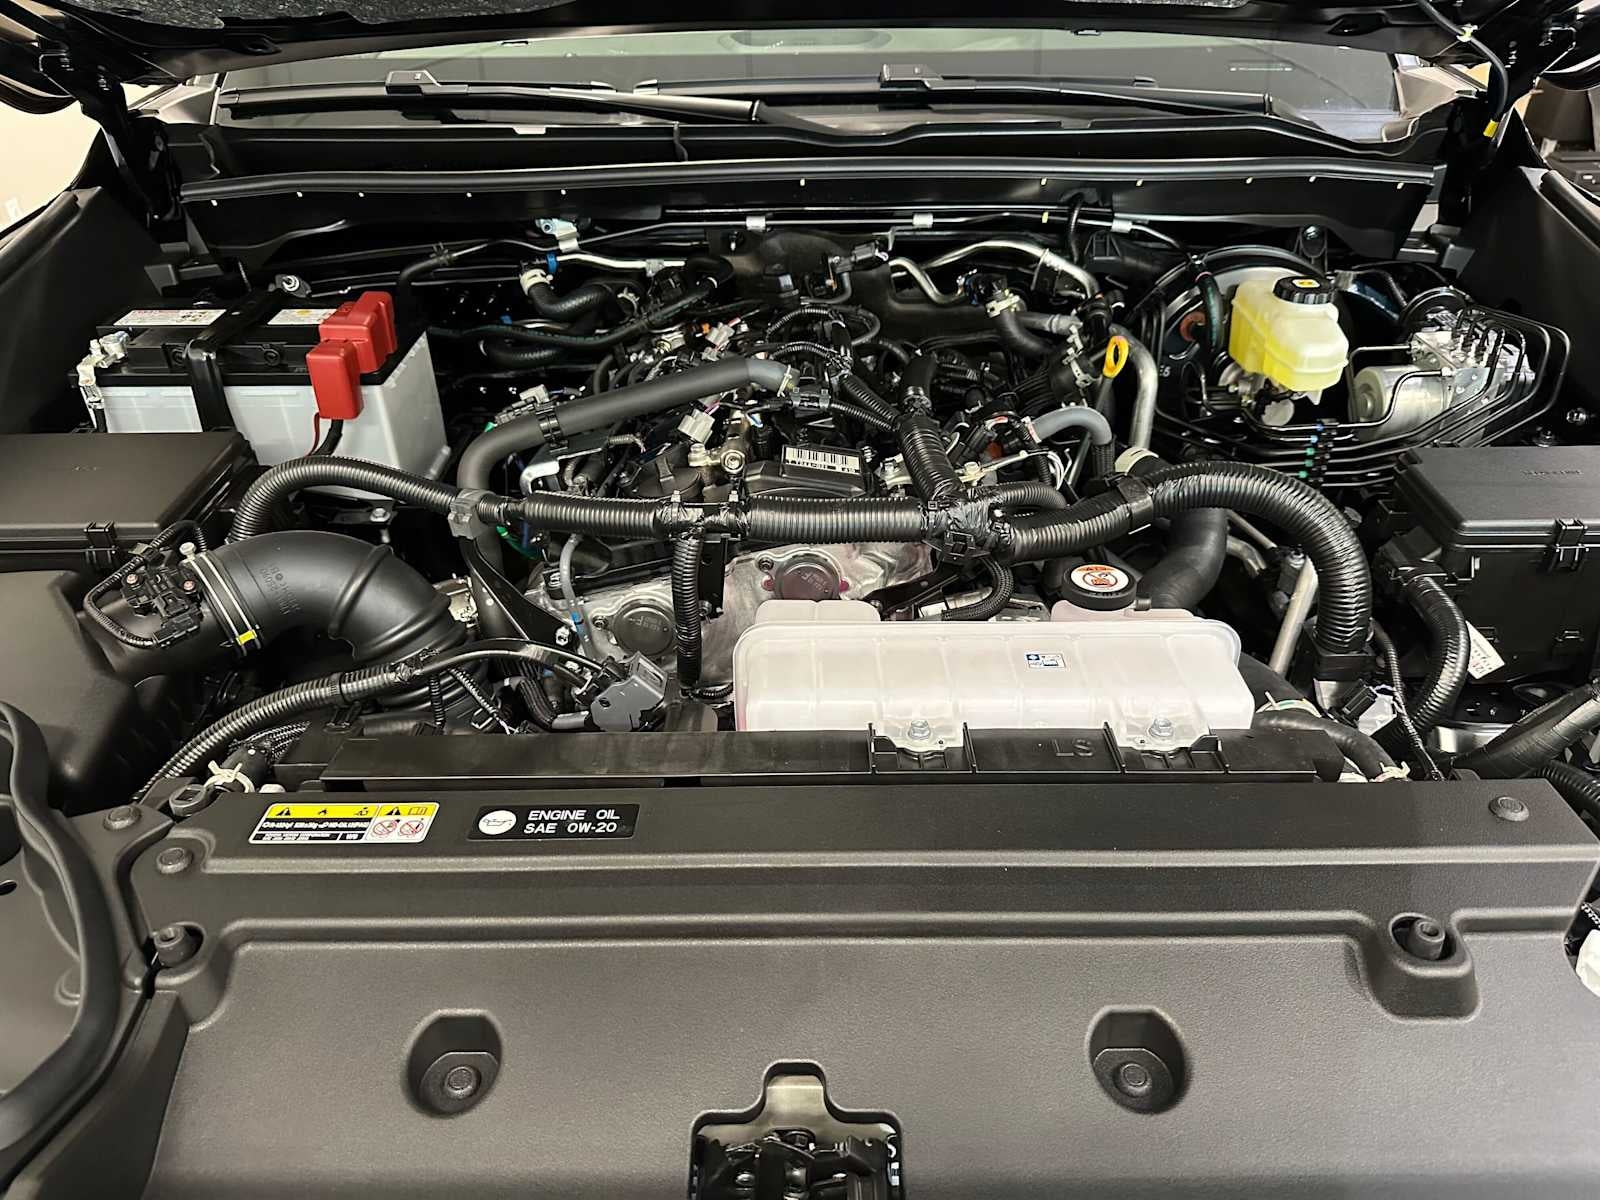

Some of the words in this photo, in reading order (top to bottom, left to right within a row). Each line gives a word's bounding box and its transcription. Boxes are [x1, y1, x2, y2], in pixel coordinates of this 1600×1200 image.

[1054, 739, 1093, 757] LS
[527, 809, 587, 821] ENGINE
[595, 809, 620, 820] OIL
[523, 822, 558, 834] SAE
[566, 822, 618, 833] 0W-20
